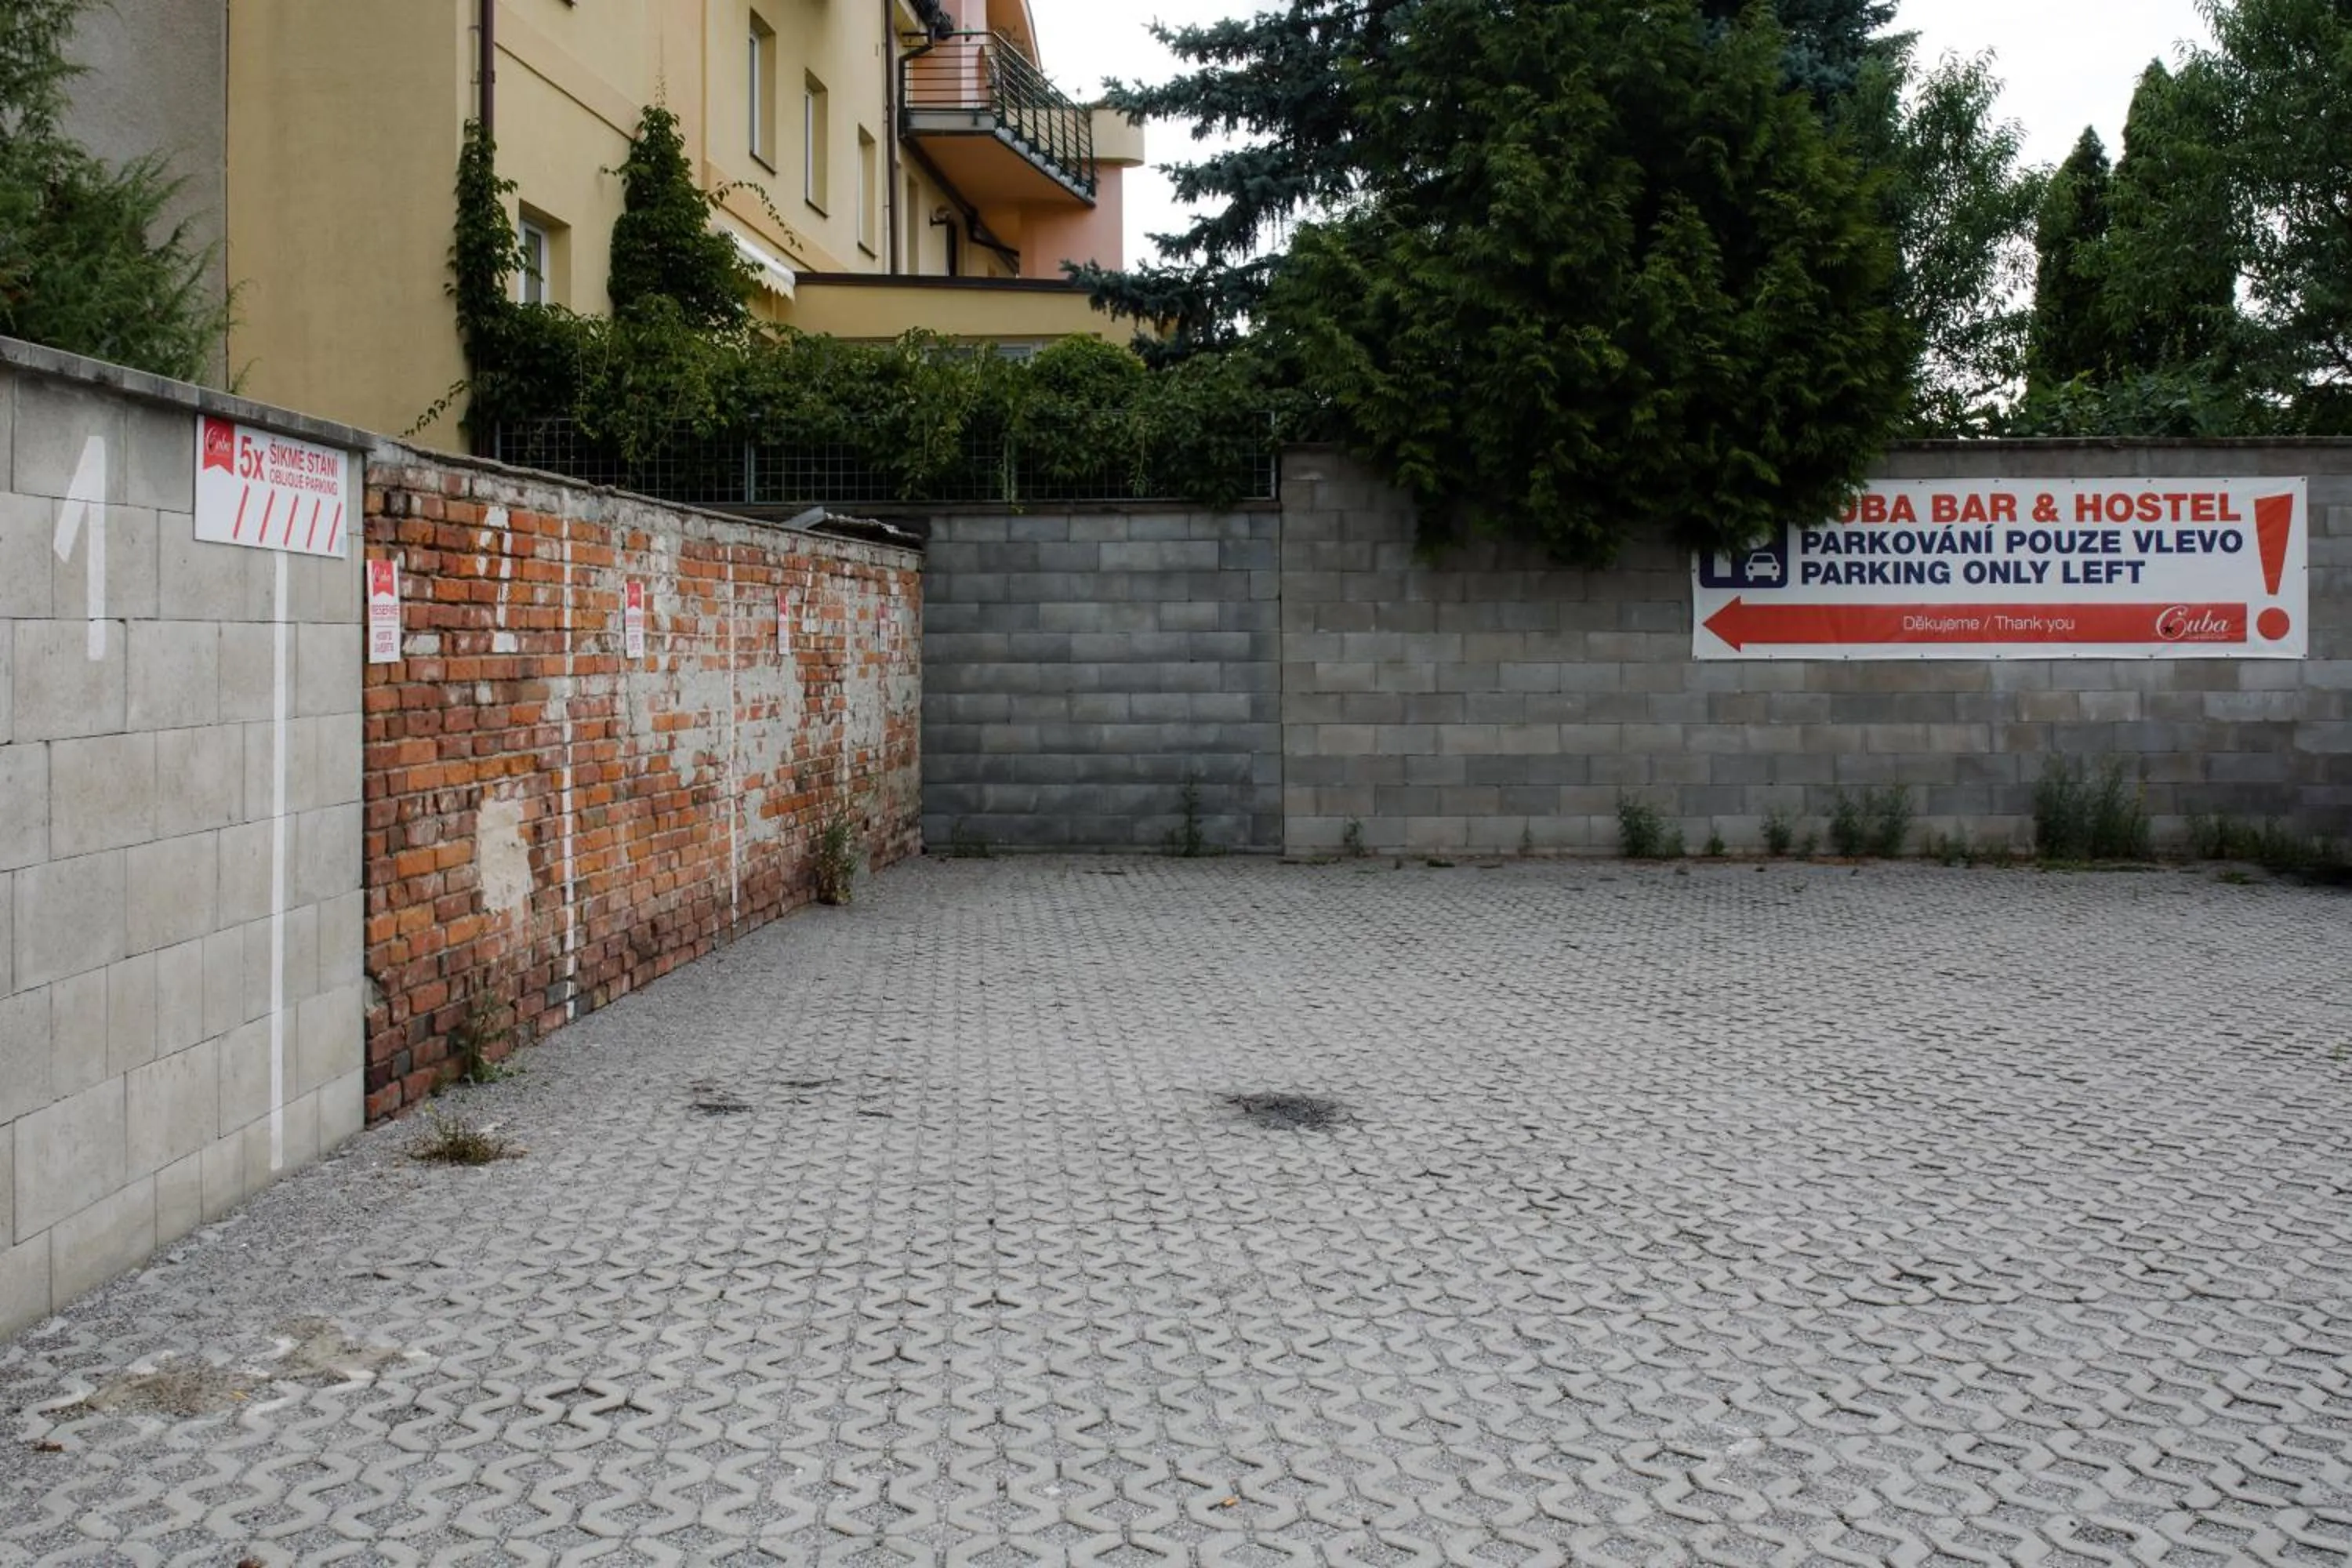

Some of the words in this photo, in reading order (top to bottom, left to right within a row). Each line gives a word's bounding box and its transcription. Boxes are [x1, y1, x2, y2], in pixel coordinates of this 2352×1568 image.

[240, 436, 264, 481] 5x
[306, 476, 338, 496] PARKING
[1836, 494, 1917, 523] UBA
[1931, 493, 2017, 523] BAR
[2032, 492, 2060, 523] &
[2075, 492, 2241, 523] HOSTEL
[1801, 524, 1994, 555] PARKOVÁNÍ
[2005, 529, 2121, 554] POUZE
[2132, 529, 2244, 554] VLEVO
[1801, 560, 1951, 585] PARKING
[1963, 560, 2051, 585] ONLY
[2063, 560, 2146, 584] LEFT
[1903, 615, 1980, 633] Děkujeme
[1994, 615, 2042, 630] Thank
[2047, 618, 2076, 633] you
[2157, 604, 2230, 641] Cuba
